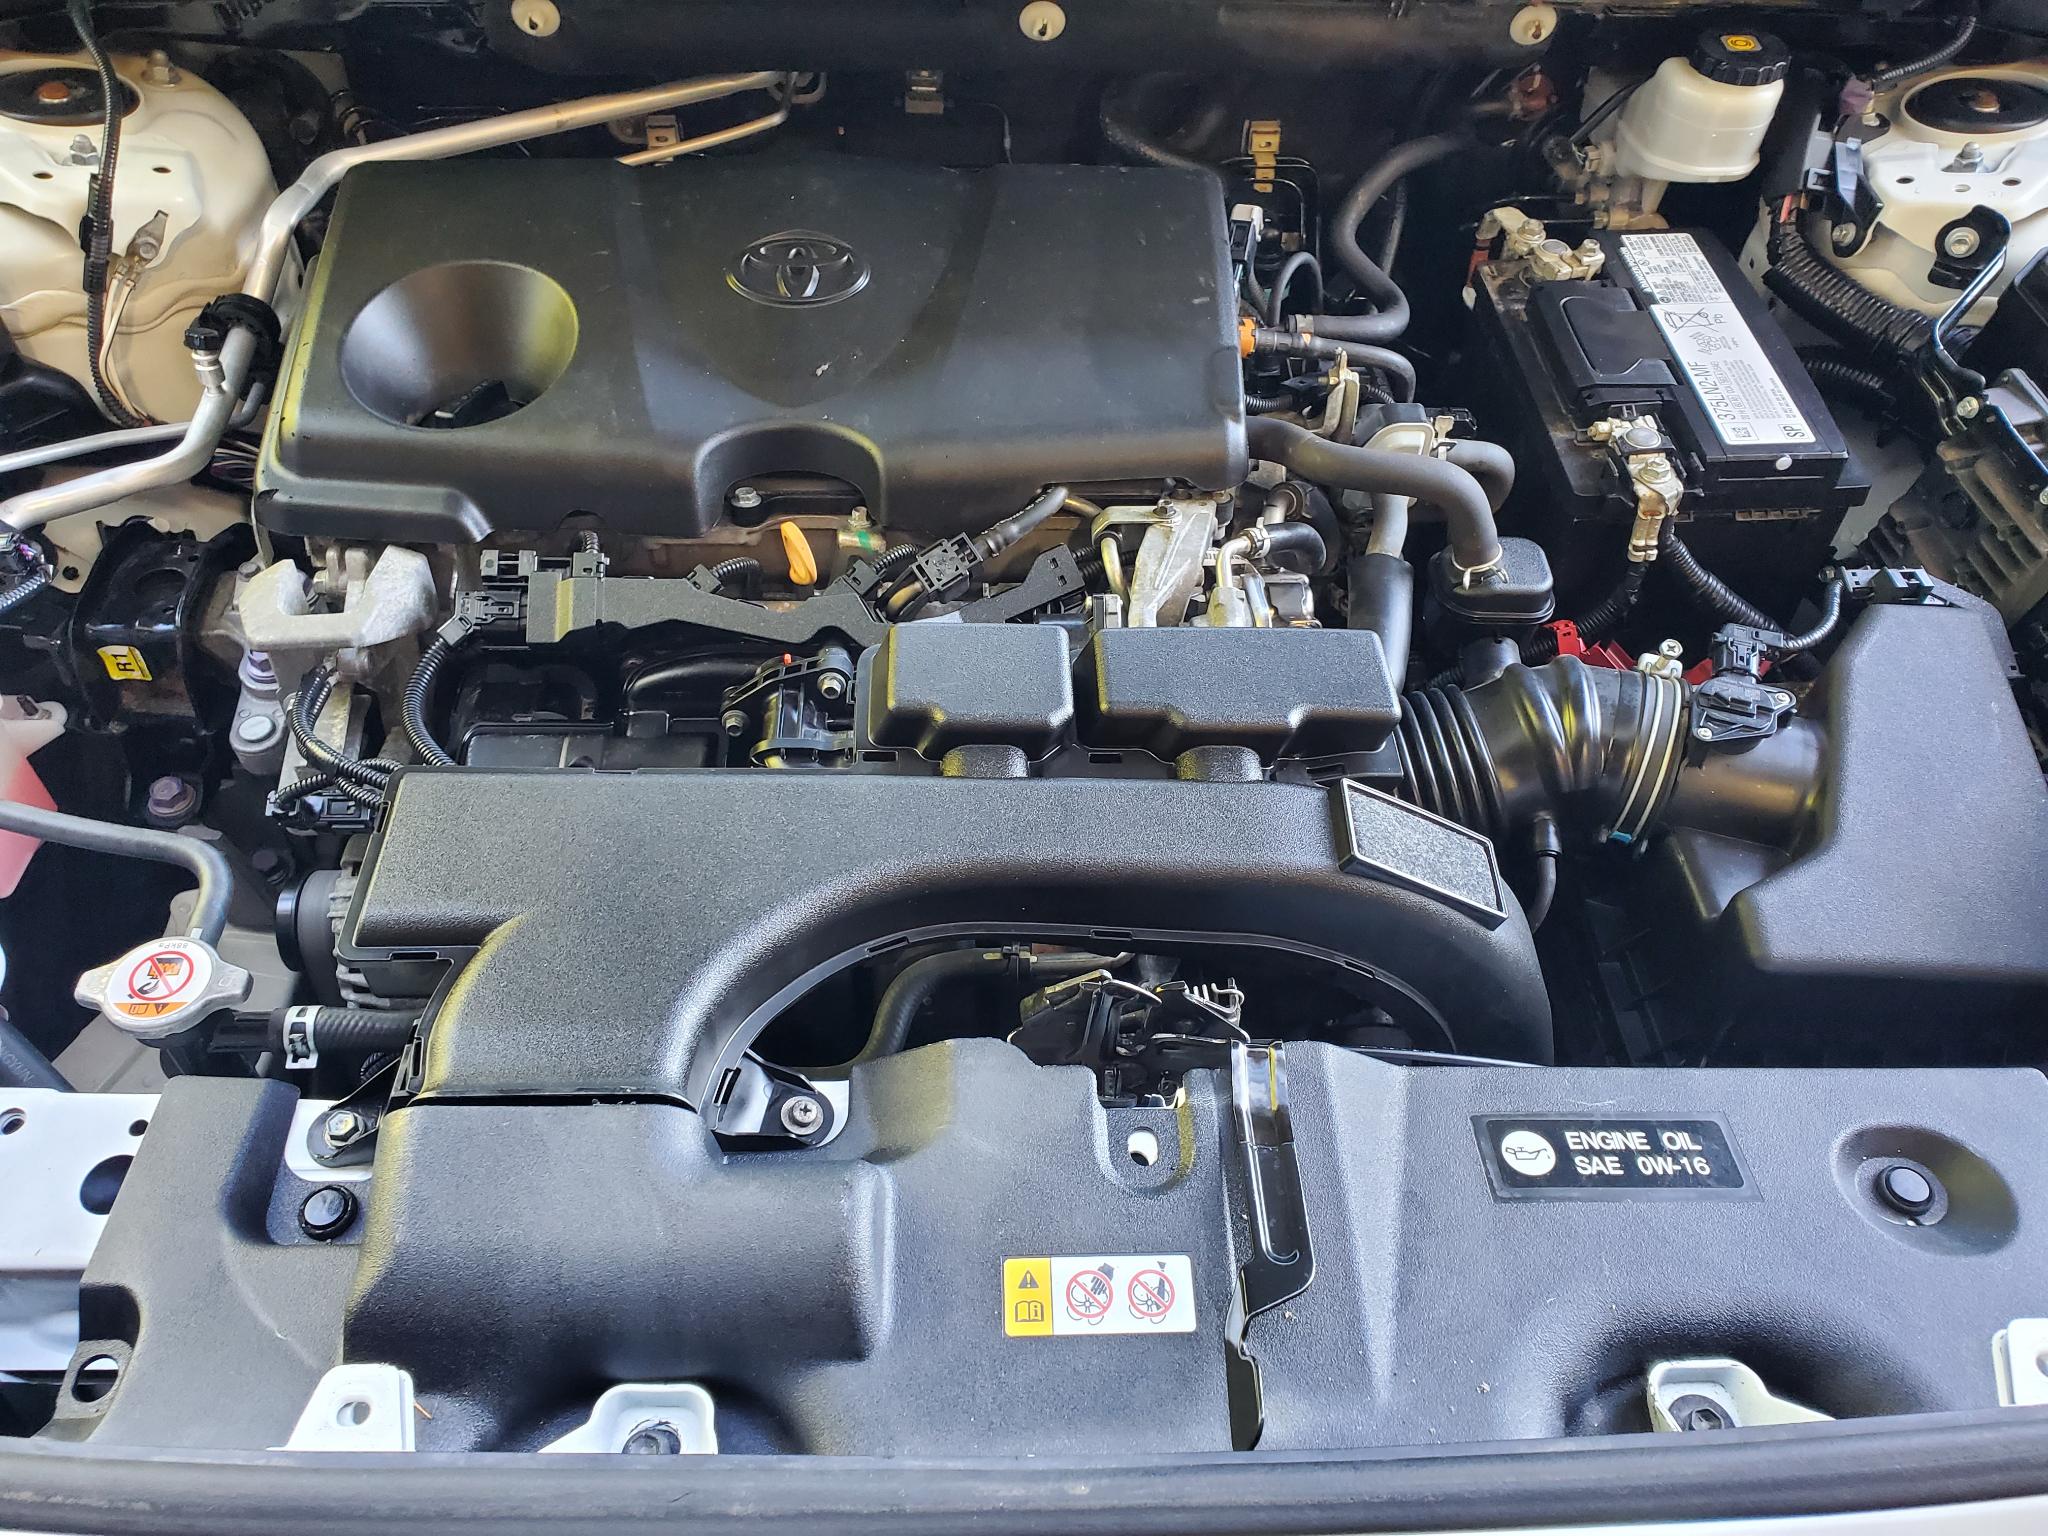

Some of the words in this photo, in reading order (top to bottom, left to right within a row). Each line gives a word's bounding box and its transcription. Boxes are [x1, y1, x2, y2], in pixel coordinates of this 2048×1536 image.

[1714, 313, 1727, 324] Pb
[1688, 361, 1736, 421] 375LN2-MF
[1783, 425, 1805, 438] SP
[111, 654, 136, 672] R1
[1565, 1131, 1651, 1151] ENGINE
[1661, 1131, 1703, 1151] OIL
[1574, 1156, 1624, 1176] SAE
[1636, 1156, 1711, 1176] 0W-16
